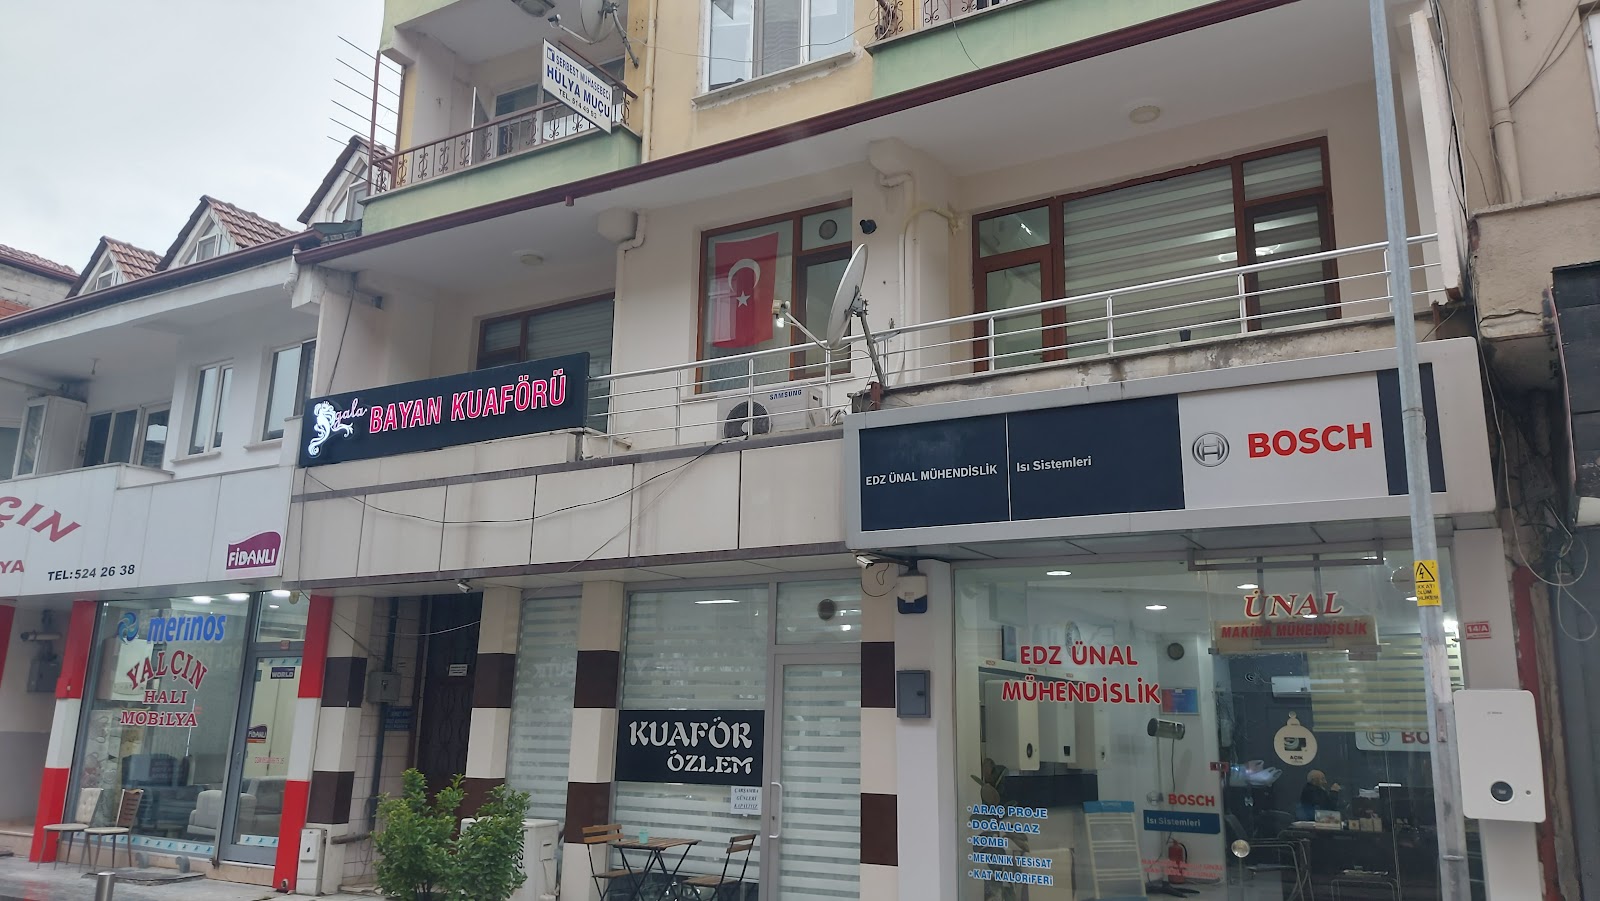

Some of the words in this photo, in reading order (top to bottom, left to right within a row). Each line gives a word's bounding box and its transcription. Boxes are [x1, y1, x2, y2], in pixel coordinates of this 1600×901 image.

[556, 55, 579, 78] SERBEST
[547, 64, 581, 98] HÜLYA
[369, 396, 442, 434] BAYAN
[450, 368, 567, 422] KUAFÖRÜ
[769, 389, 802, 400] SAMSUNG
[1247, 422, 1373, 459] BOSCH
[1016, 462, 1030, 472] Isı
[1033, 455, 1092, 472] Sistemleri
[865, 474, 887, 486] EDZ
[889, 471, 918, 484] ÜNAL
[920, 463, 998, 481] MÜHENDİSLİK
[228, 547, 276, 567] FİDANLI
[100, 566, 116, 578] 26
[119, 564, 136, 576] 38
[1245, 589, 1343, 618] ÜNAL
[146, 614, 226, 643] merinos
[1221, 622, 1272, 638] MAKİNA
[1276, 620, 1368, 638] MÜHENDİSLİK
[1467, 625, 1488, 633] 14/A
[1020, 645, 1062, 665] EDZ
[1071, 641, 1138, 666] ÜNAL
[127, 649, 208, 691] YALÇIN
[271, 671, 294, 679] WORLD
[143, 690, 188, 705] HALI
[1002, 675, 1161, 704] MÜHENDİSLİK
[629, 716, 753, 749] KUAFÖR
[667, 749, 753, 775] ÖZLEM
[1168, 793, 1215, 807] BOSCH
[972, 804, 1005, 818] ARAÇ
[1008, 806, 1048, 819] PROJE
[972, 819, 1040, 834] DOĞALGAZ
[1158, 817, 1201, 827] Sistemleri
[973, 869, 992, 880] KAT
